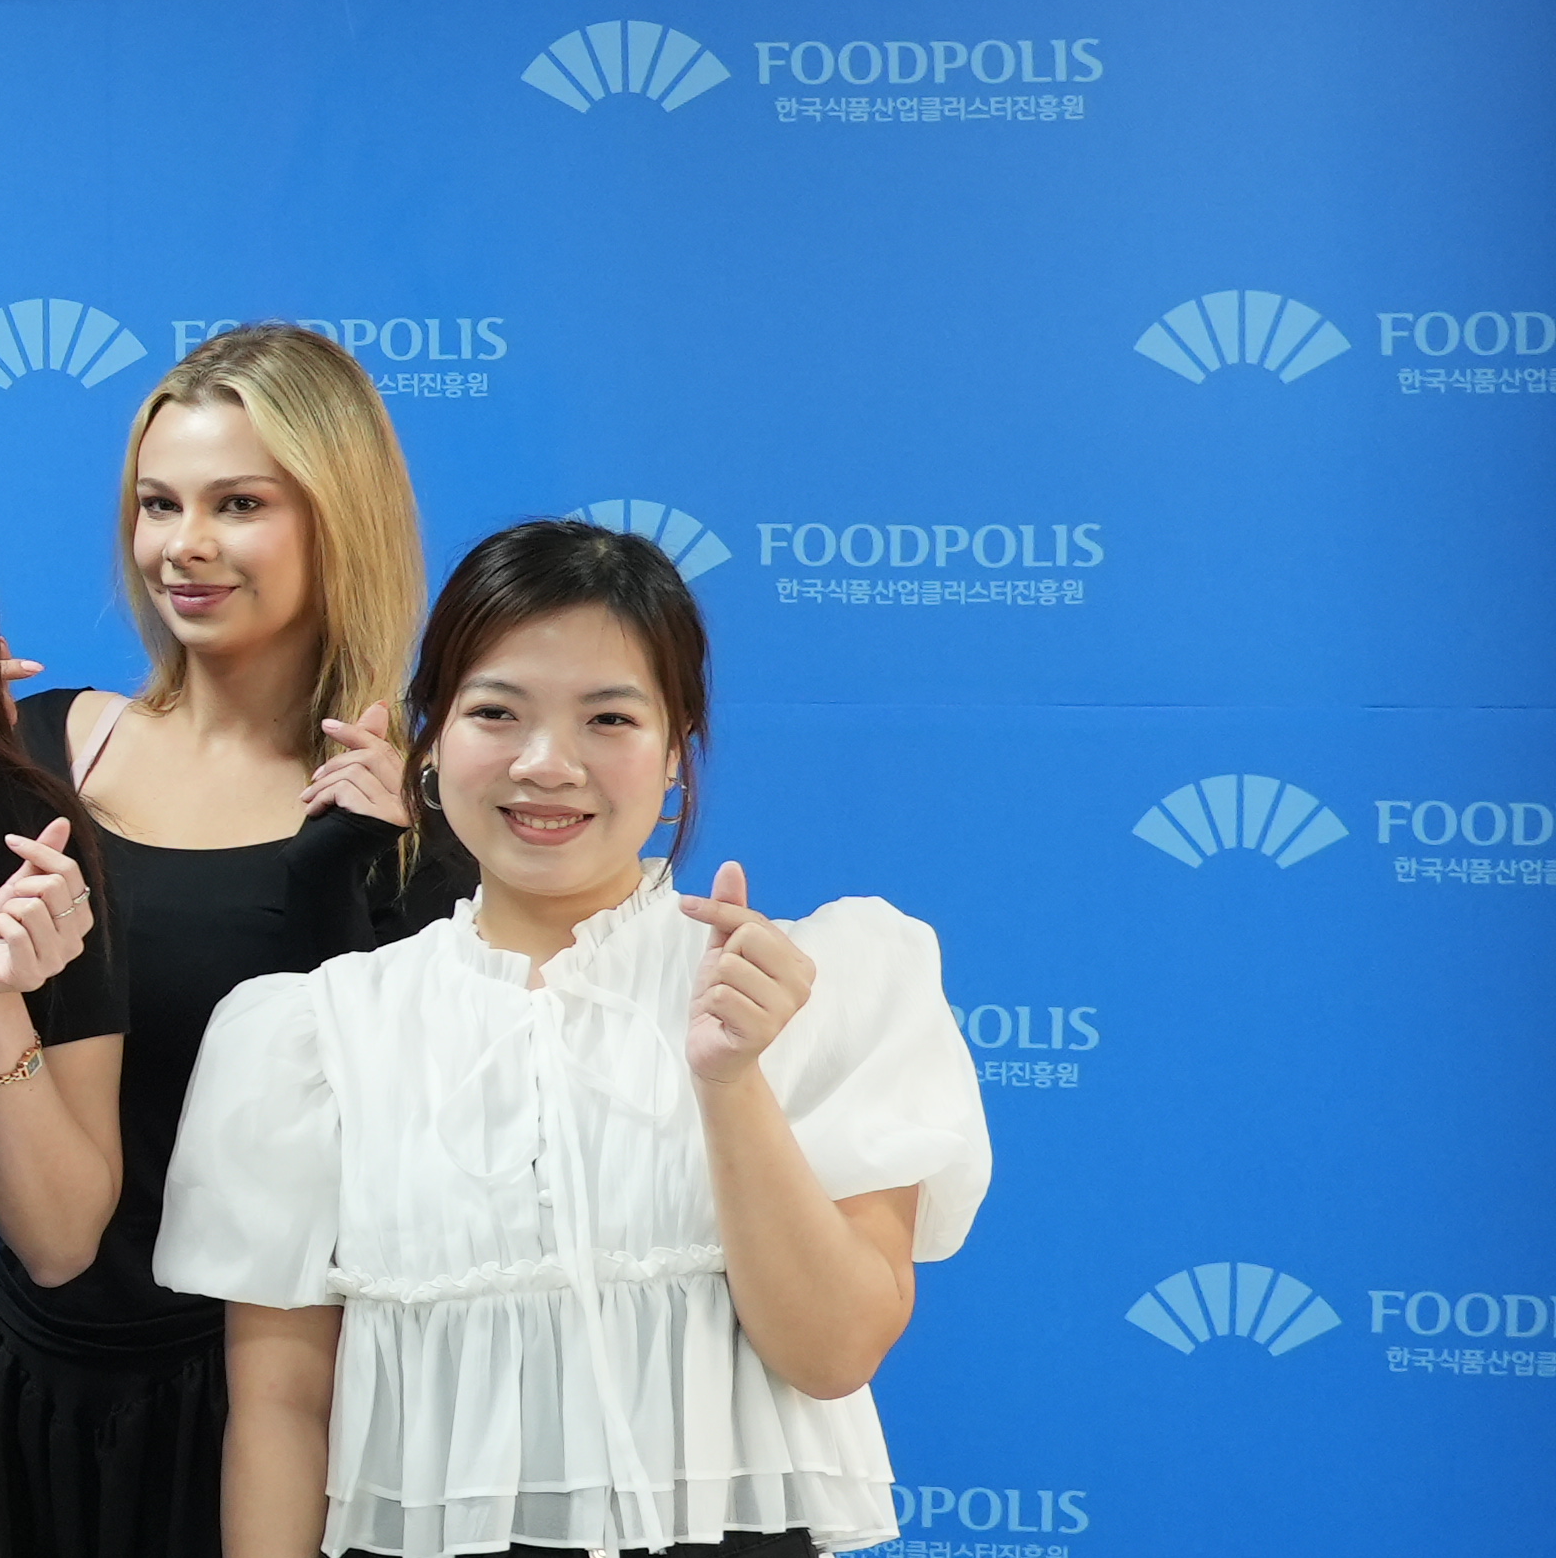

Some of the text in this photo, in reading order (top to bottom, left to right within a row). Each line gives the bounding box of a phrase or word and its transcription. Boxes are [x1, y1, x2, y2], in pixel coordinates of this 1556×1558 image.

[754, 39, 1103, 84] FOODPOLIS
[775, 95, 1084, 122] 한국식품산업클러스터진흥원
[172, 317, 507, 361] FPOLIS
[1396, 368, 1556, 394] 한국식품산업
[757, 523, 1103, 568] FOODPOLIS
[776, 579, 1083, 605] 한국식품산업클러스터진흥원
[1374, 800, 1556, 846] FOOD
[1368, 1290, 1556, 1338] FOOD
